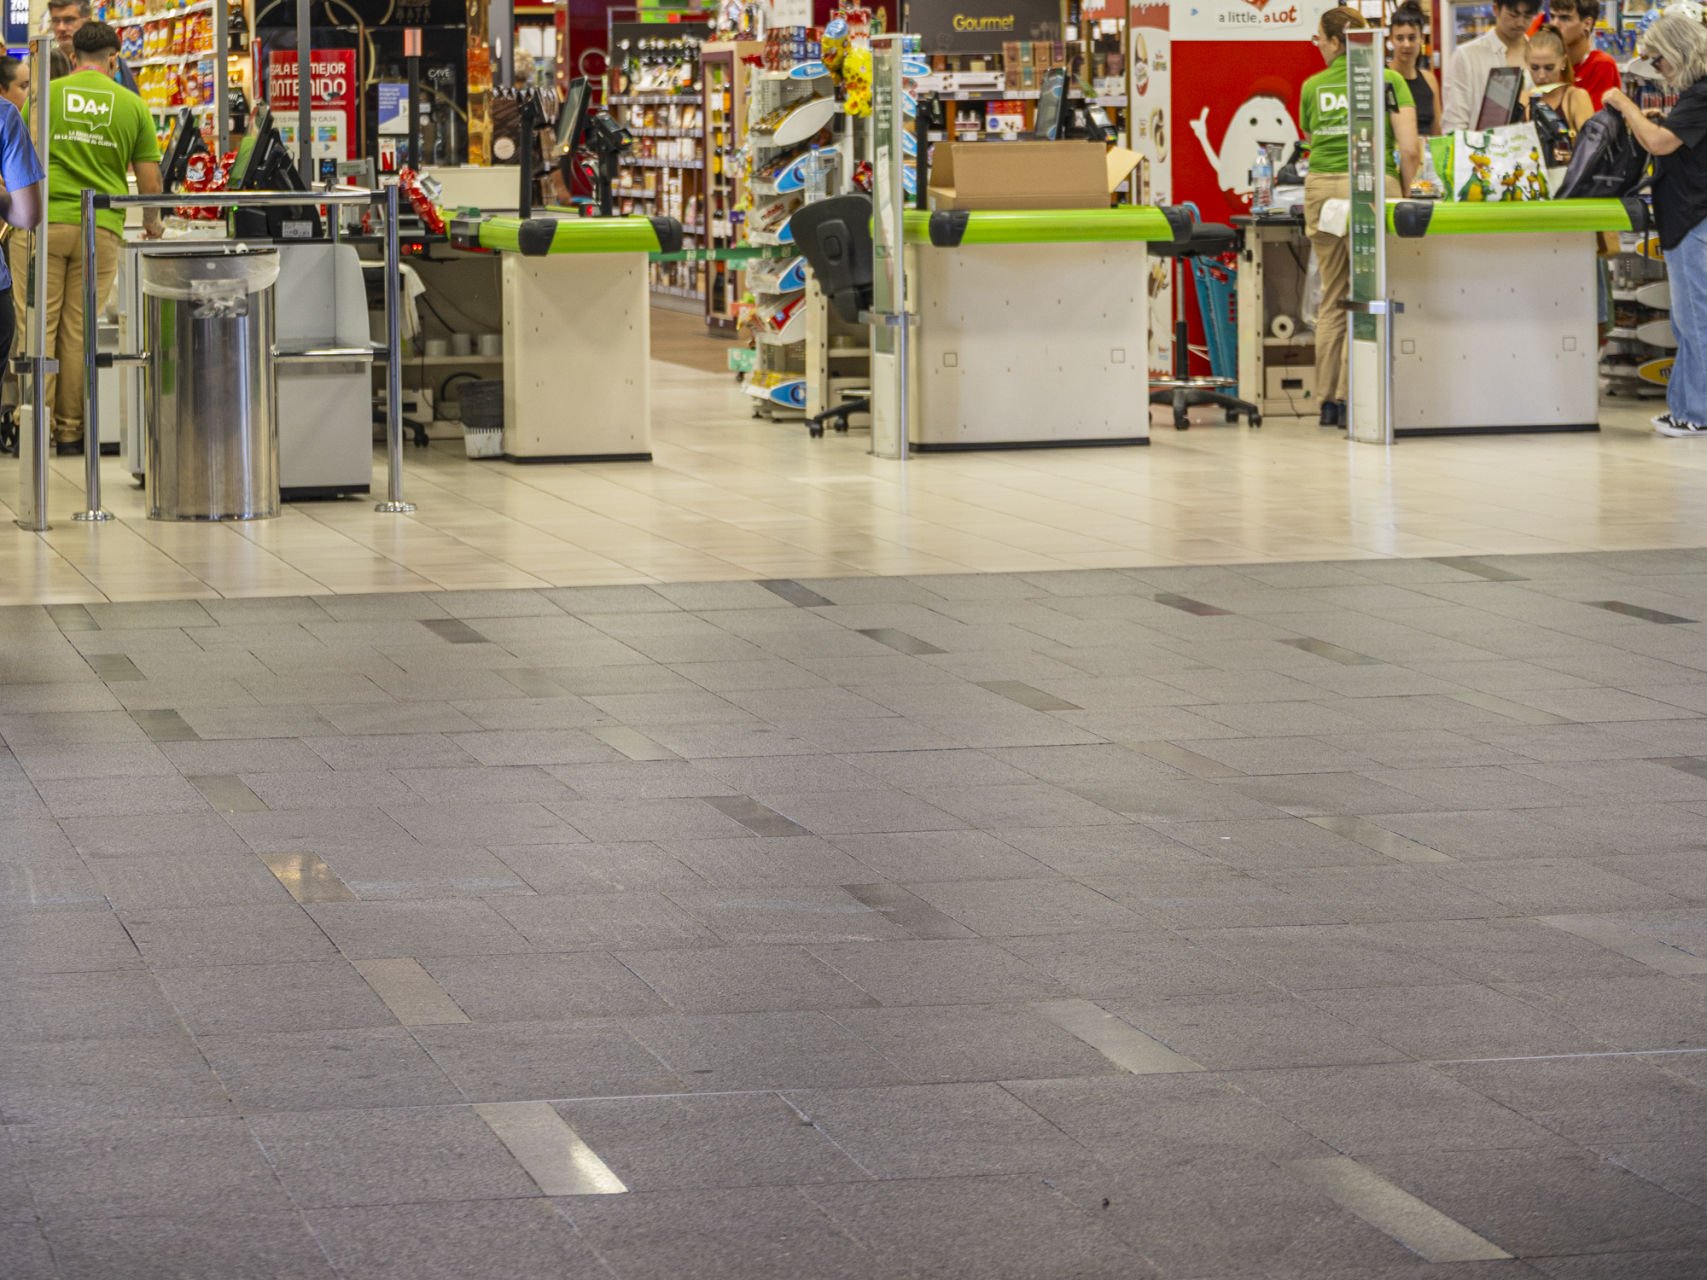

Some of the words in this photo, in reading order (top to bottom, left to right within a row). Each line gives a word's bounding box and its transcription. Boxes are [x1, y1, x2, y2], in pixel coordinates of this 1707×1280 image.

[953, 14, 1014, 31] Gourmet
[1219, 14, 1225, 23] a
[1264, 14, 1270, 23] a
[310, 62, 346, 77] MEJOR
[67, 93, 109, 115] DA+
[1320, 92, 1348, 112] DA
